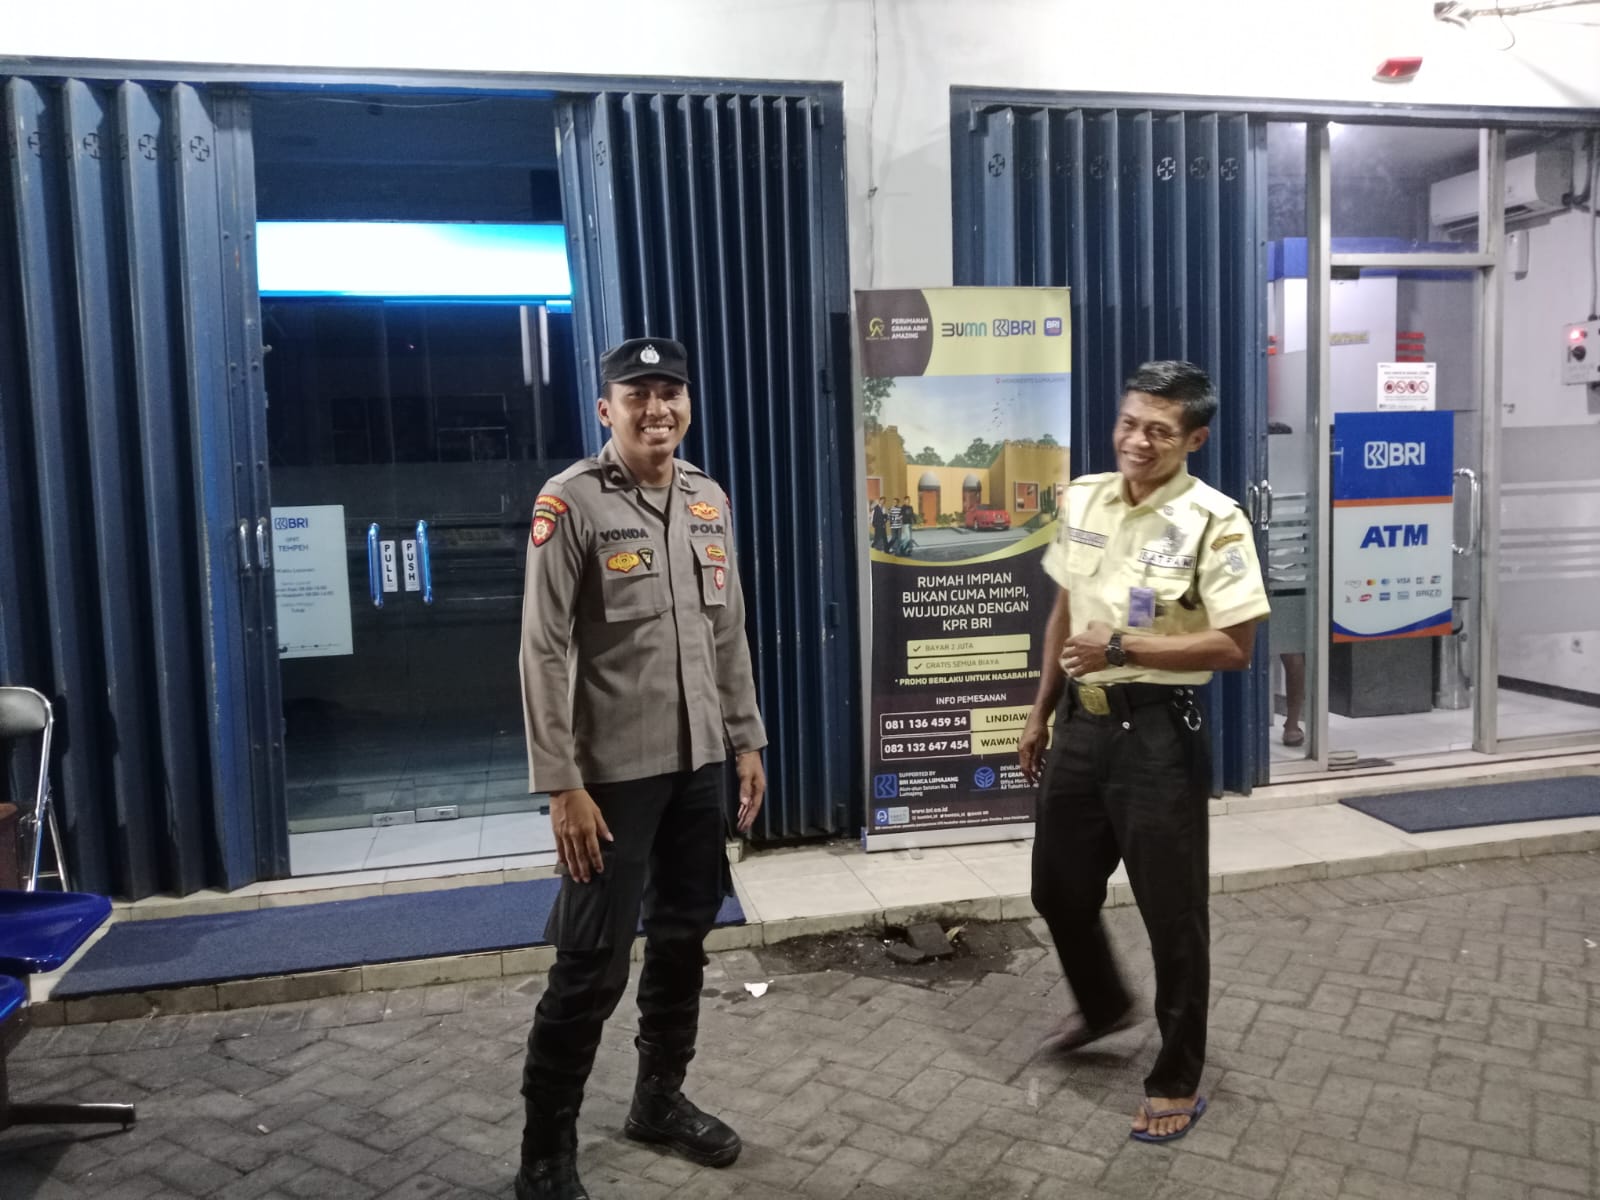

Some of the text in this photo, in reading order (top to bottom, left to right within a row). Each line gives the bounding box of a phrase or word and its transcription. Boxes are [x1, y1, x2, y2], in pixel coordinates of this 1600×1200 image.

[1010, 320, 1036, 335] BRI
[1046, 320, 1060, 329] BRI
[891, 331, 919, 340] AMAZING
[1389, 442, 1426, 466] BRI
[287, 518, 309, 529] BRI
[690, 523, 724, 534] POLR
[1360, 524, 1429, 549] ATM
[278, 544, 309, 552] TEMPEH
[383, 544, 393, 583] PULL
[405, 543, 416, 581] PUSH
[917, 572, 1012, 588] RUMAH IMPIAN
[902, 586, 1029, 604] BUKAN CUMA MIMPI,
[902, 601, 1029, 618] WUJUDKAN DENGAN
[943, 617, 992, 631] KPR BRI
[925, 644, 950, 652] BAYAR
[957, 642, 974, 651] JUTA
[925, 658, 1000, 670] GRATIS SEMUA BIAYA
[899, 670, 1041, 686] PROMO BERLAKU UNTUK NASABAH BRI
[936, 693, 1007, 705] INFO PEMESANAN
[885, 716, 967, 730] 081 136 459 54
[986, 712, 1030, 723] LINDIAW
[884, 740, 969, 754] 082 132 647 454
[981, 737, 1020, 747] WAWAN
[928, 776, 959, 784] LUMAJANG
